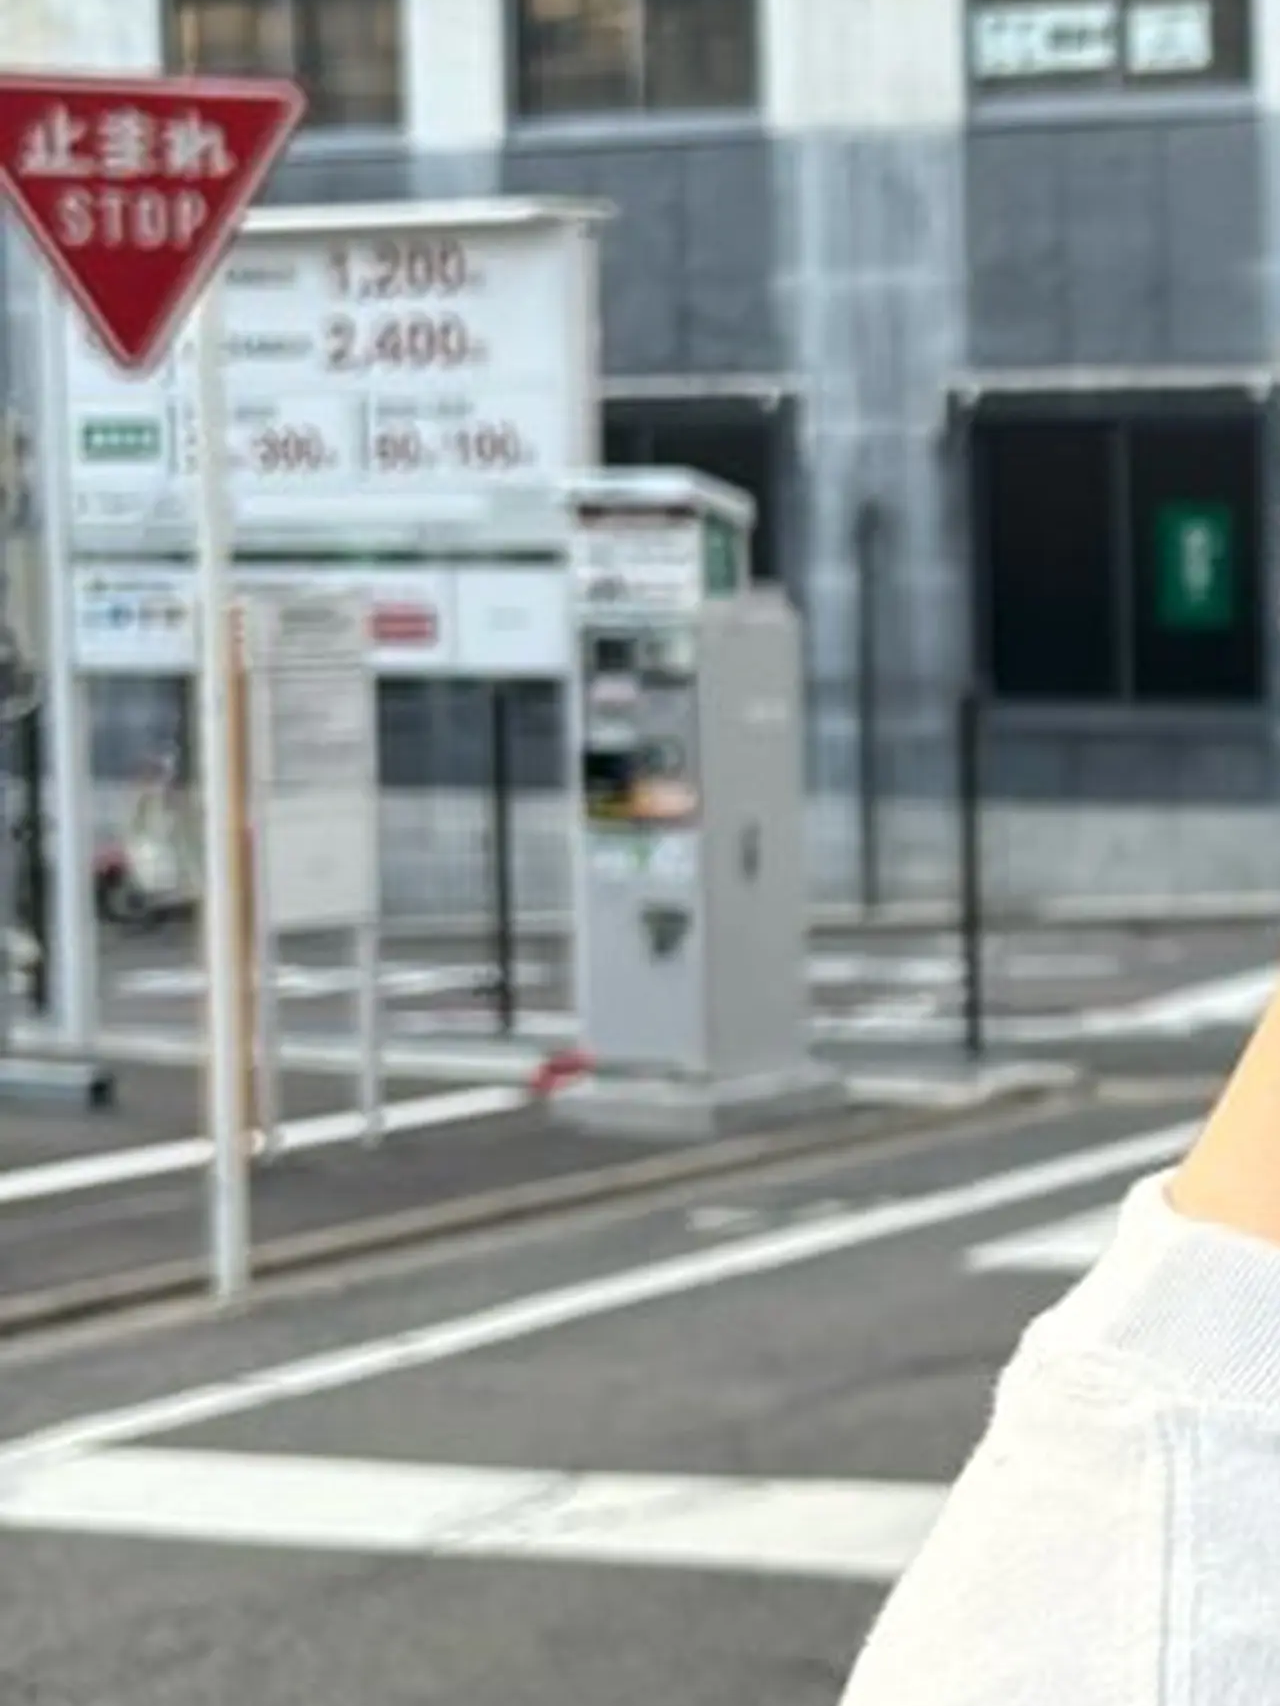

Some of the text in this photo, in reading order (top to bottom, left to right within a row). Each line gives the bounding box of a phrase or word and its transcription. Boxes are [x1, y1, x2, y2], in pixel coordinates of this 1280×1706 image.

[20, 99, 237, 178] 止まれ
[57, 184, 207, 250] STOP
